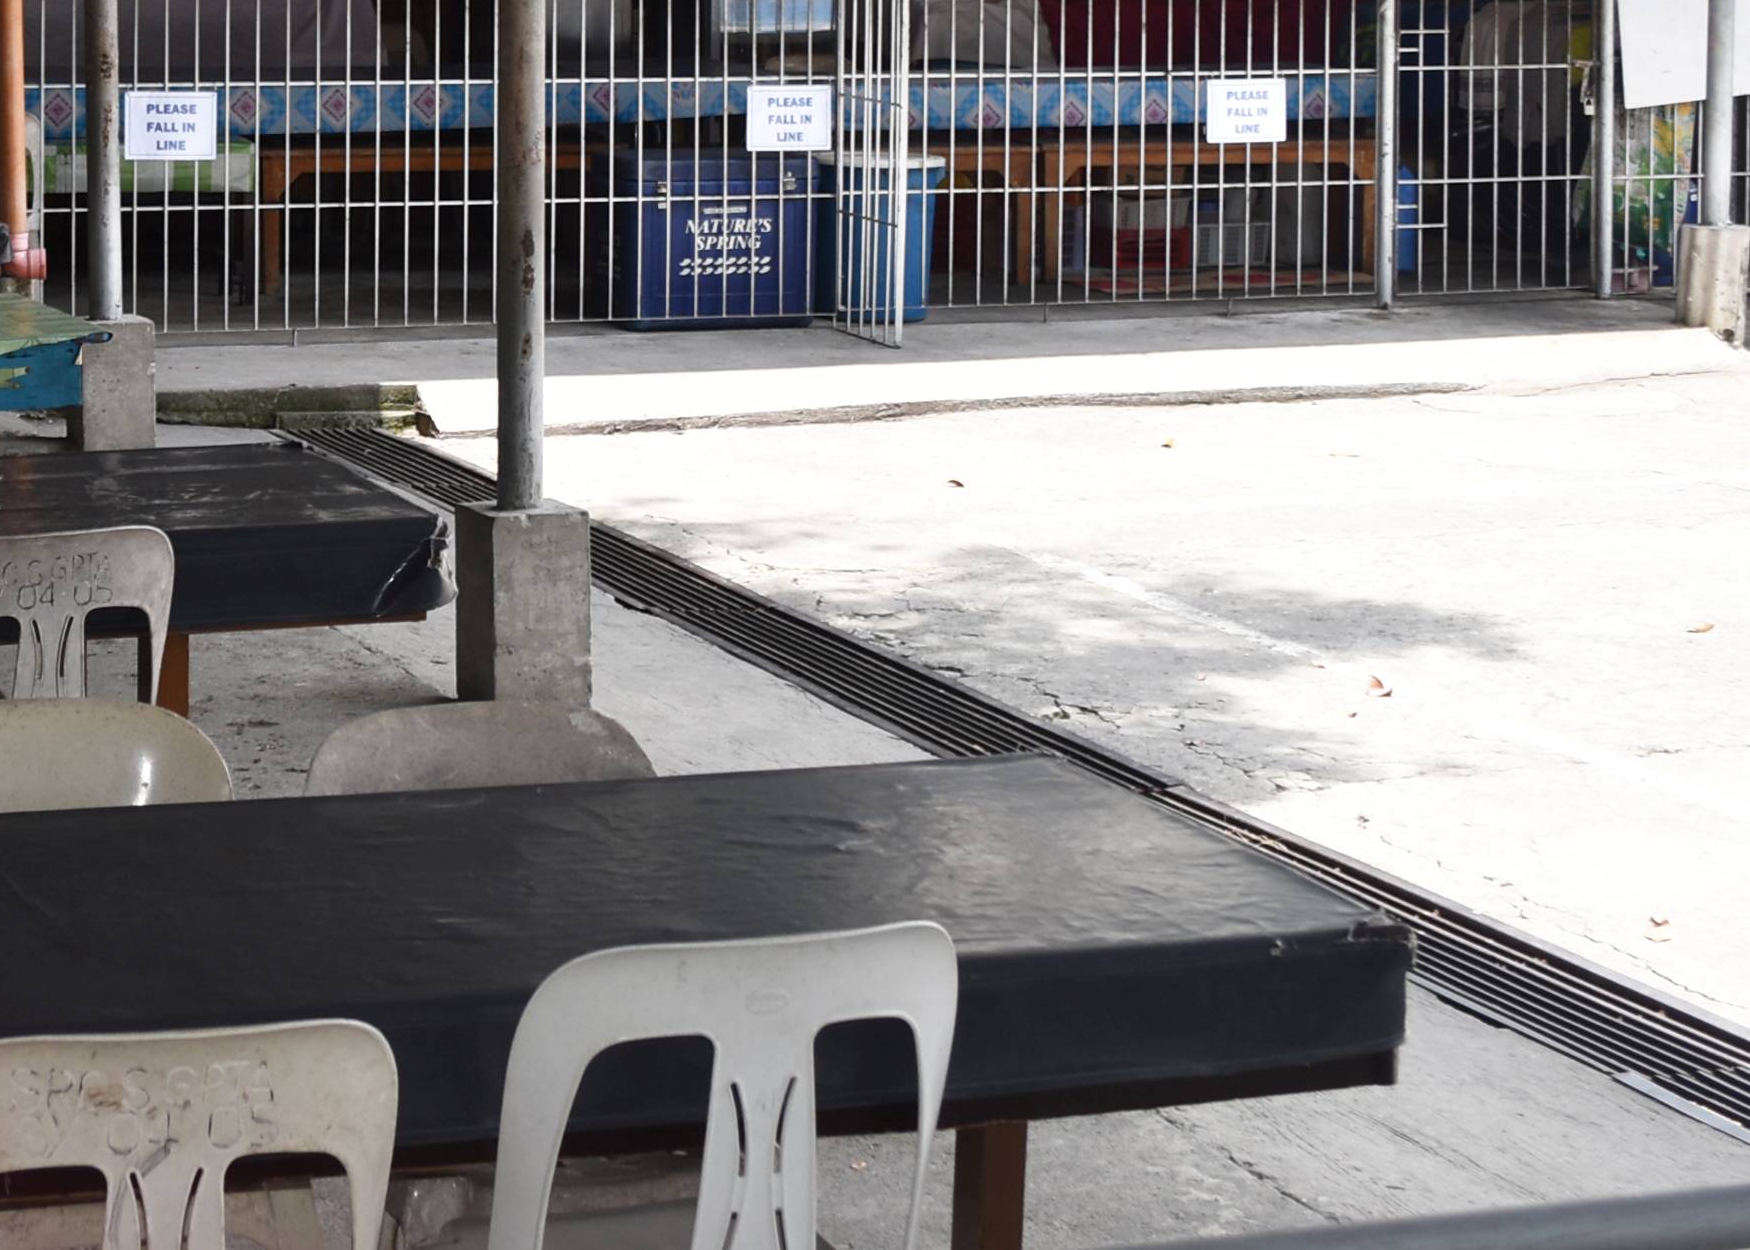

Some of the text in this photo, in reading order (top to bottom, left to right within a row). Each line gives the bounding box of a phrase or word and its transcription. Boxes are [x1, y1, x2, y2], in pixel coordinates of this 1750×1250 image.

[1226, 90, 1269, 101] PLEASE
[767, 97, 813, 108] PLEASE
[146, 103, 197, 115] PLEASE
[1227, 108, 1268, 117] FALL IN
[768, 115, 812, 125] FALL IN
[146, 122, 196, 133] FALL IN
[1235, 124, 1260, 134] LINE
[777, 132, 803, 142] LINE
[156, 140, 186, 151] LINE
[696, 235, 761, 251] SPRING
[17, 581, 55, 610] 04
[74, 581, 113, 607] 05
